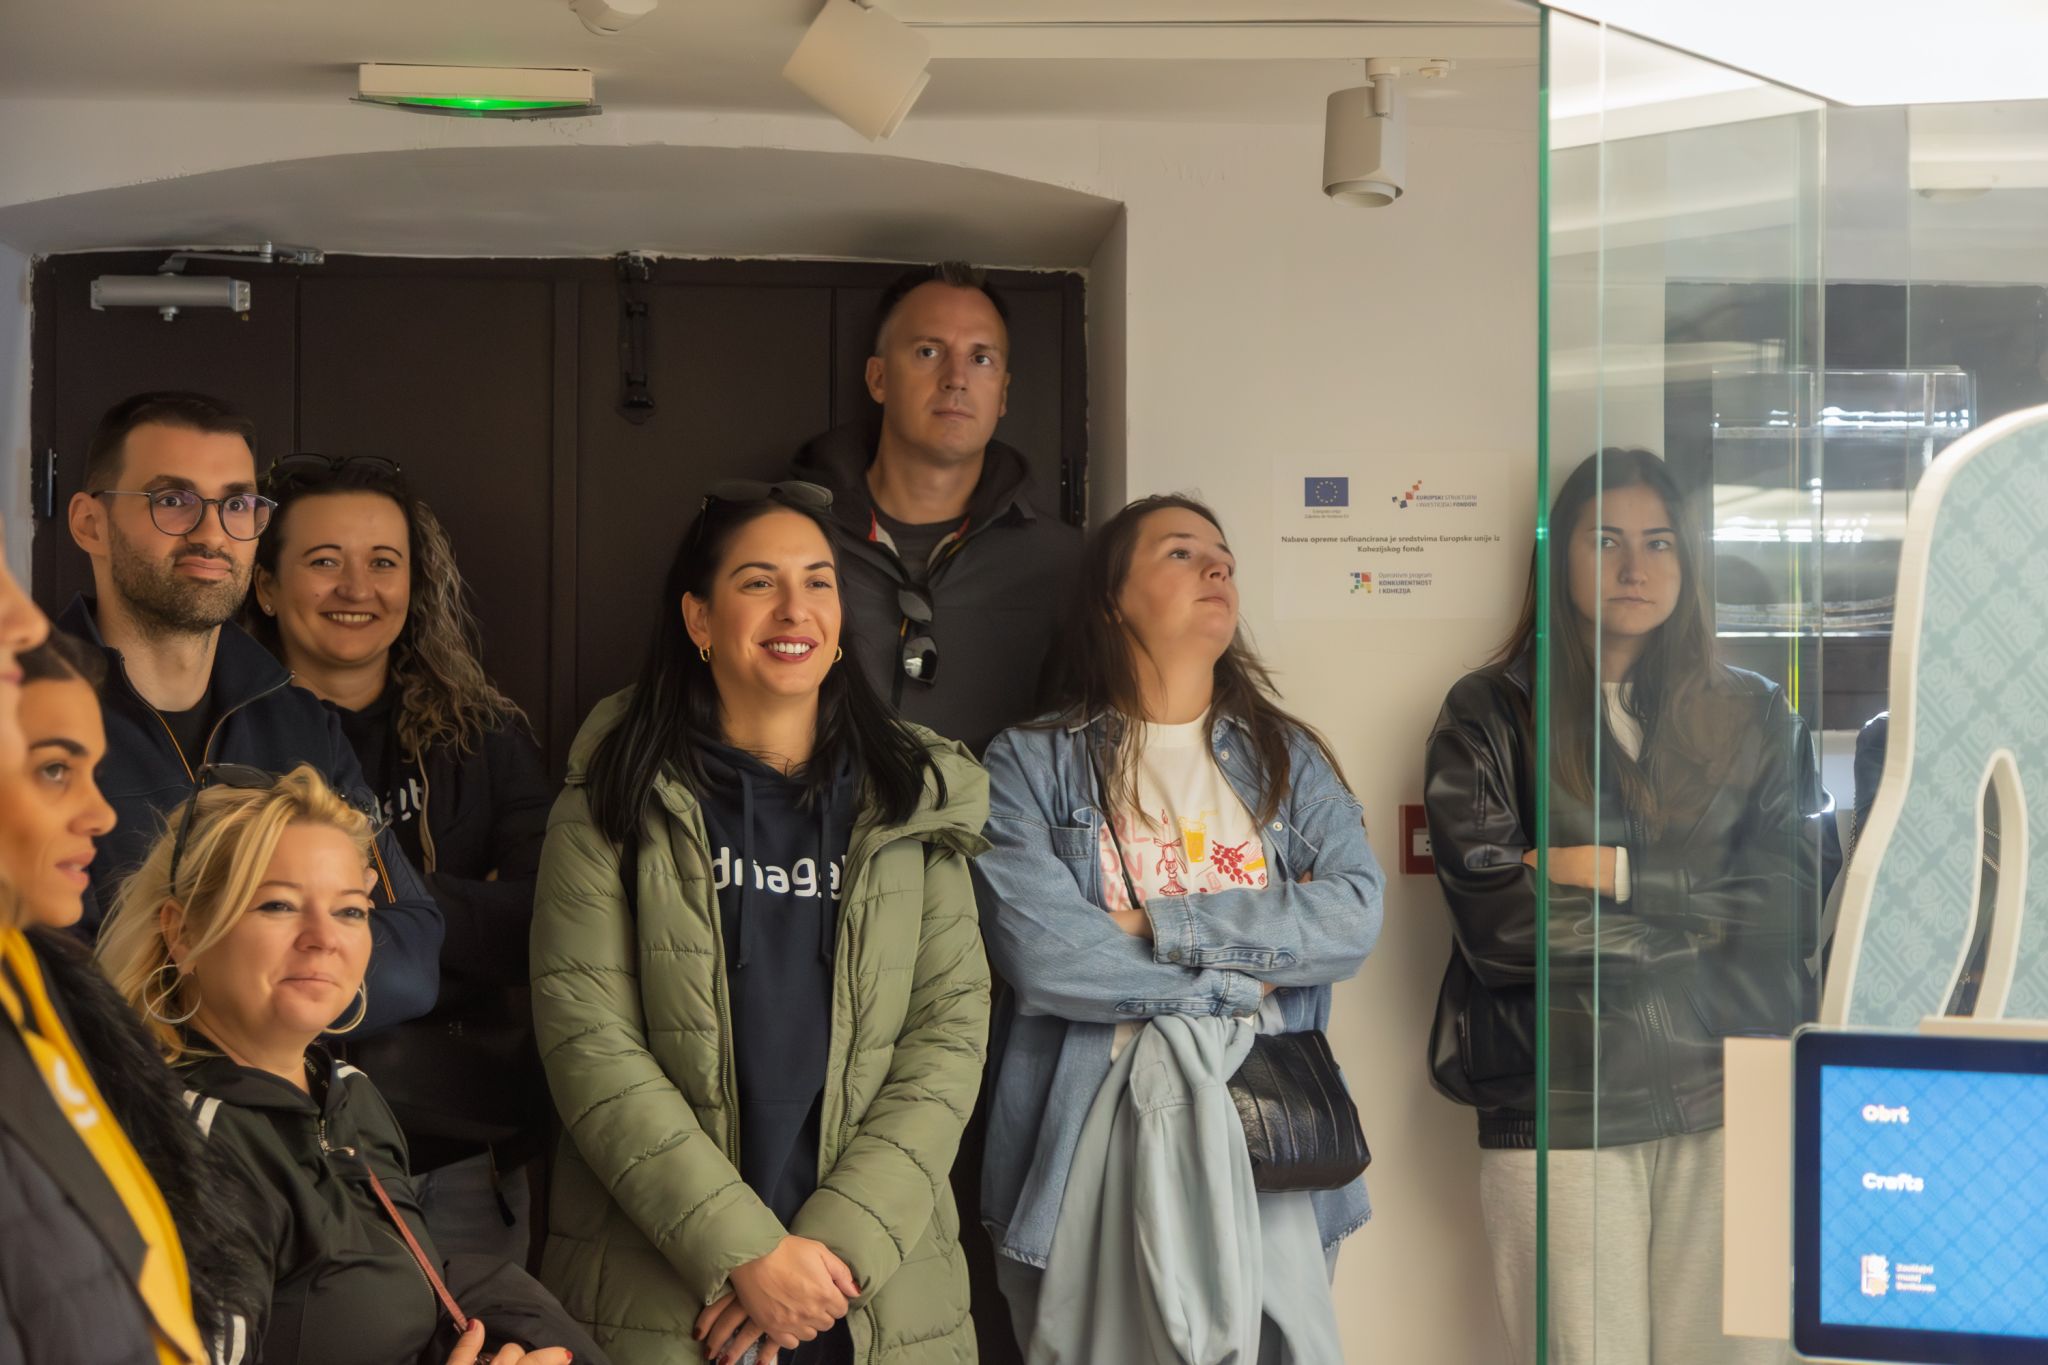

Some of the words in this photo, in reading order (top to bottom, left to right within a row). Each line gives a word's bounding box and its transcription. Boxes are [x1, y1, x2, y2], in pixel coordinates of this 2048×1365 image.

[1281, 535, 1309, 543] Nabava
[1310, 537, 1338, 545] opreme
[1340, 535, 1388, 543] sufinancirana
[1389, 535, 1397, 545] je
[1439, 535, 1472, 544] Europske
[1474, 535, 1492, 544] unije
[1357, 545, 1401, 554] Kohezijskog
[1403, 545, 1424, 553] fonda
[1862, 1104, 1909, 1123] Obrt
[1862, 1172, 1924, 1191] Crafts
